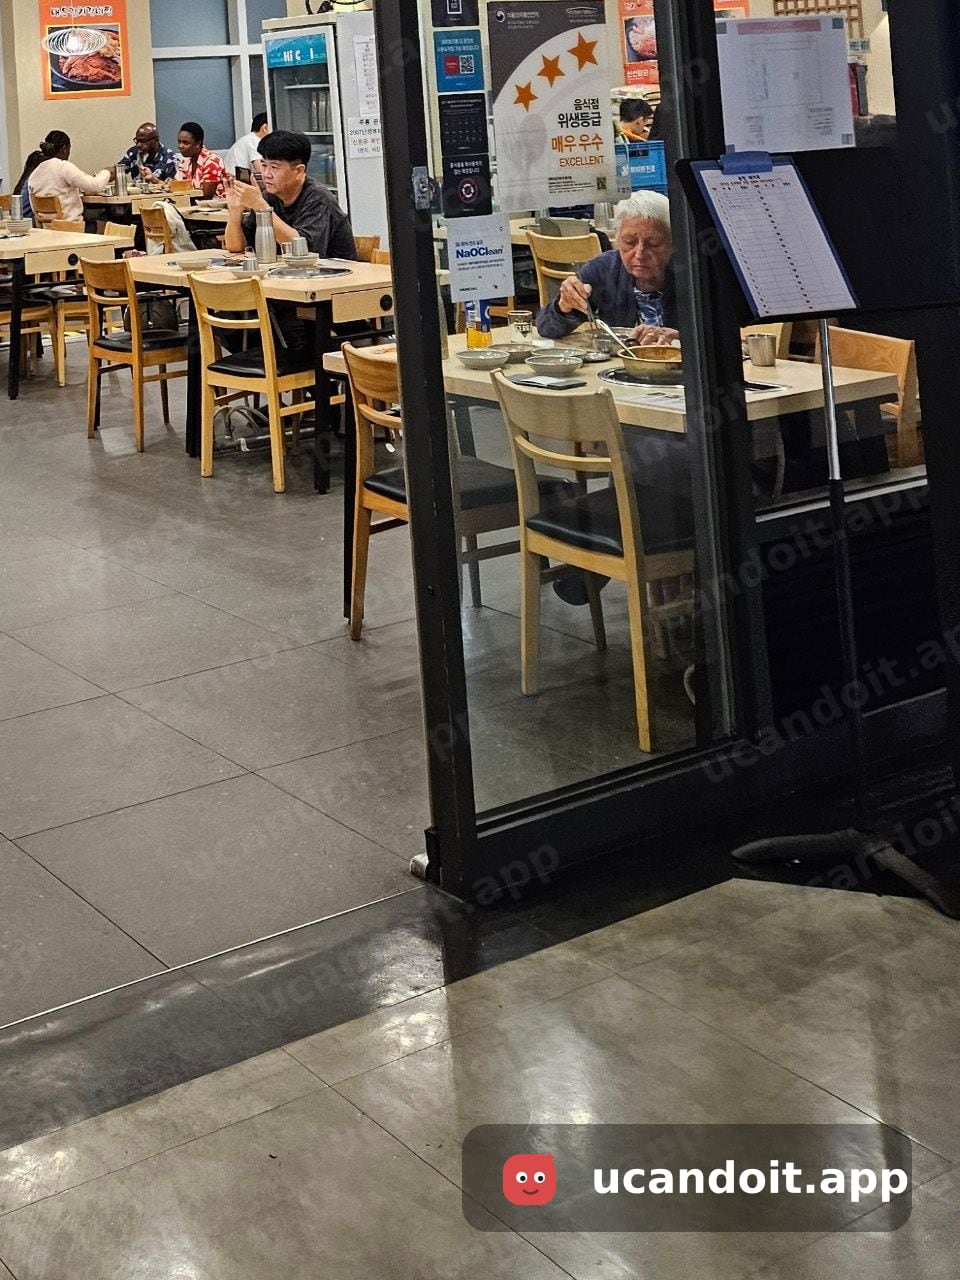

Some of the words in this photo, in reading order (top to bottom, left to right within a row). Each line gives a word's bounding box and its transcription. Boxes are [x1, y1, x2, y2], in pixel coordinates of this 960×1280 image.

[573, 97, 600, 111] 음식점
[557, 111, 602, 129] 위생등급
[551, 134, 577, 153] 매우
[578, 133, 604, 151] 우수
[559, 155, 605, 168] EXCELLENT
[455, 246, 503, 258] NaOClean
